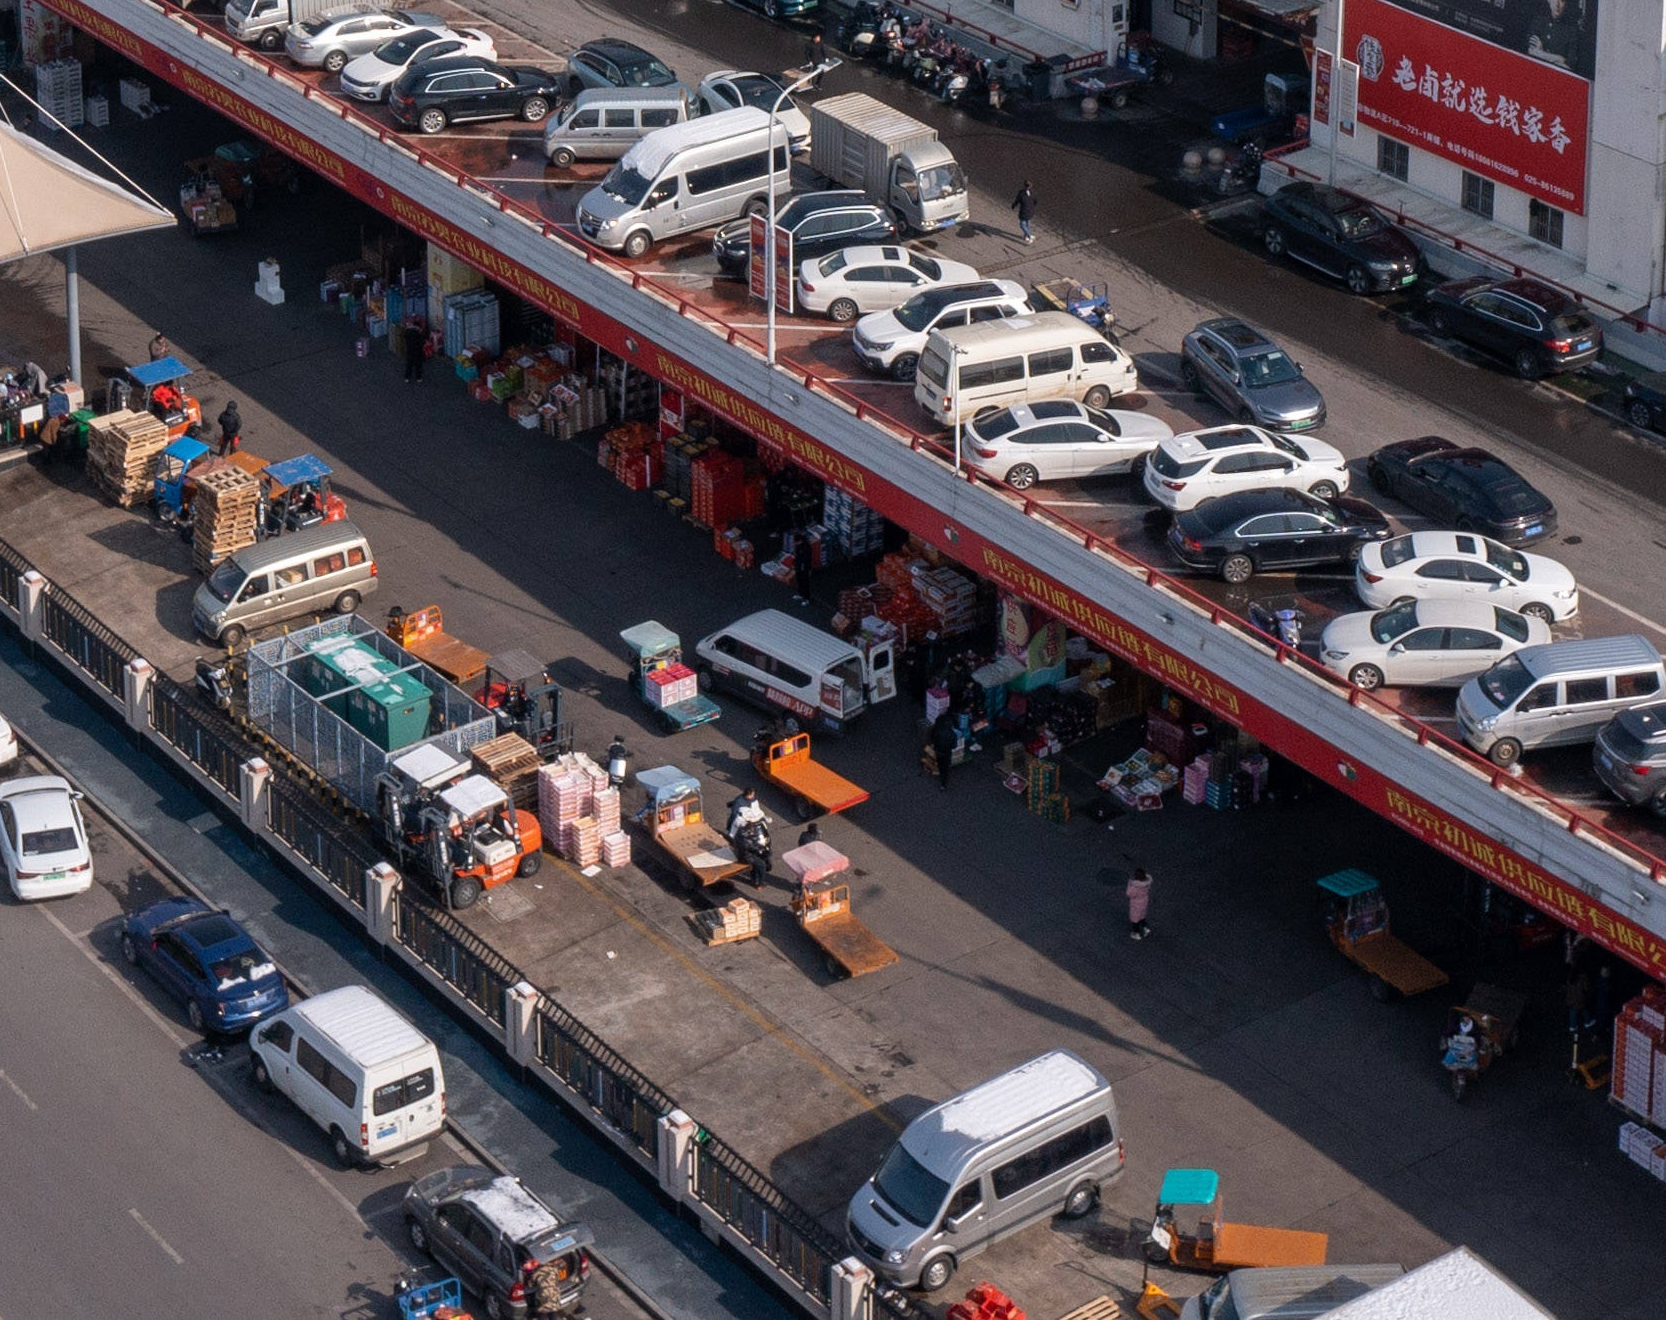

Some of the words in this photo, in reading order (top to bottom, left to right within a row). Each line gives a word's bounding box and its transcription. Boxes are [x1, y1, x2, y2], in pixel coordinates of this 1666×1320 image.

[1391, 54, 1573, 155] 老卤就选钱家香
